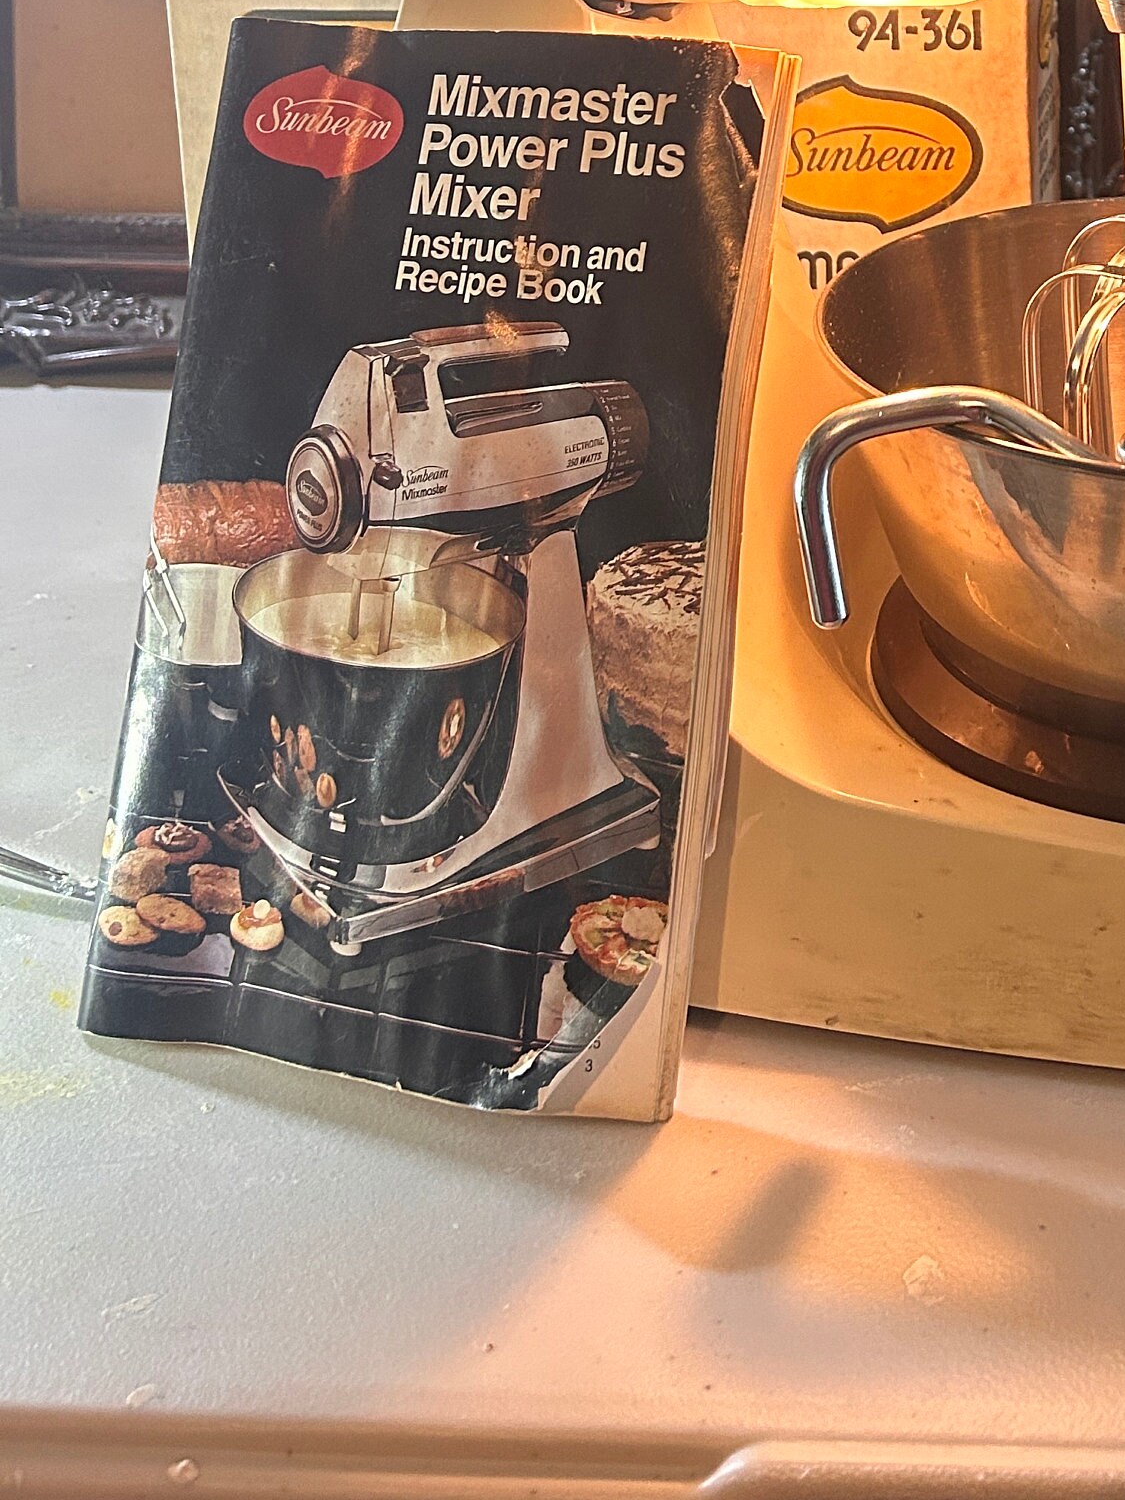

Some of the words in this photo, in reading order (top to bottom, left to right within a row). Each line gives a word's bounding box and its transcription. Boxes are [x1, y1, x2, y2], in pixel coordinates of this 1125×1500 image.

[848, 8, 983, 51] 94-361
[255, 95, 394, 142] Sunbeam
[426, 73, 677, 126] Mixmaster
[417, 123, 568, 170] Power
[578, 131, 687, 178] Plus
[786, 125, 956, 178] Sunbeam
[407, 172, 541, 221] Mixer
[400, 227, 580, 270] Instruction
[590, 242, 647, 273] and
[394, 260, 507, 303] Recipe
[516, 267, 603, 305] Book
[564, 436, 605, 454] ELECTRONIC
[579, 452, 603, 465] WATTS
[401, 465, 449, 487] Sunbeam
[401, 484, 448, 501] Mixmaster
